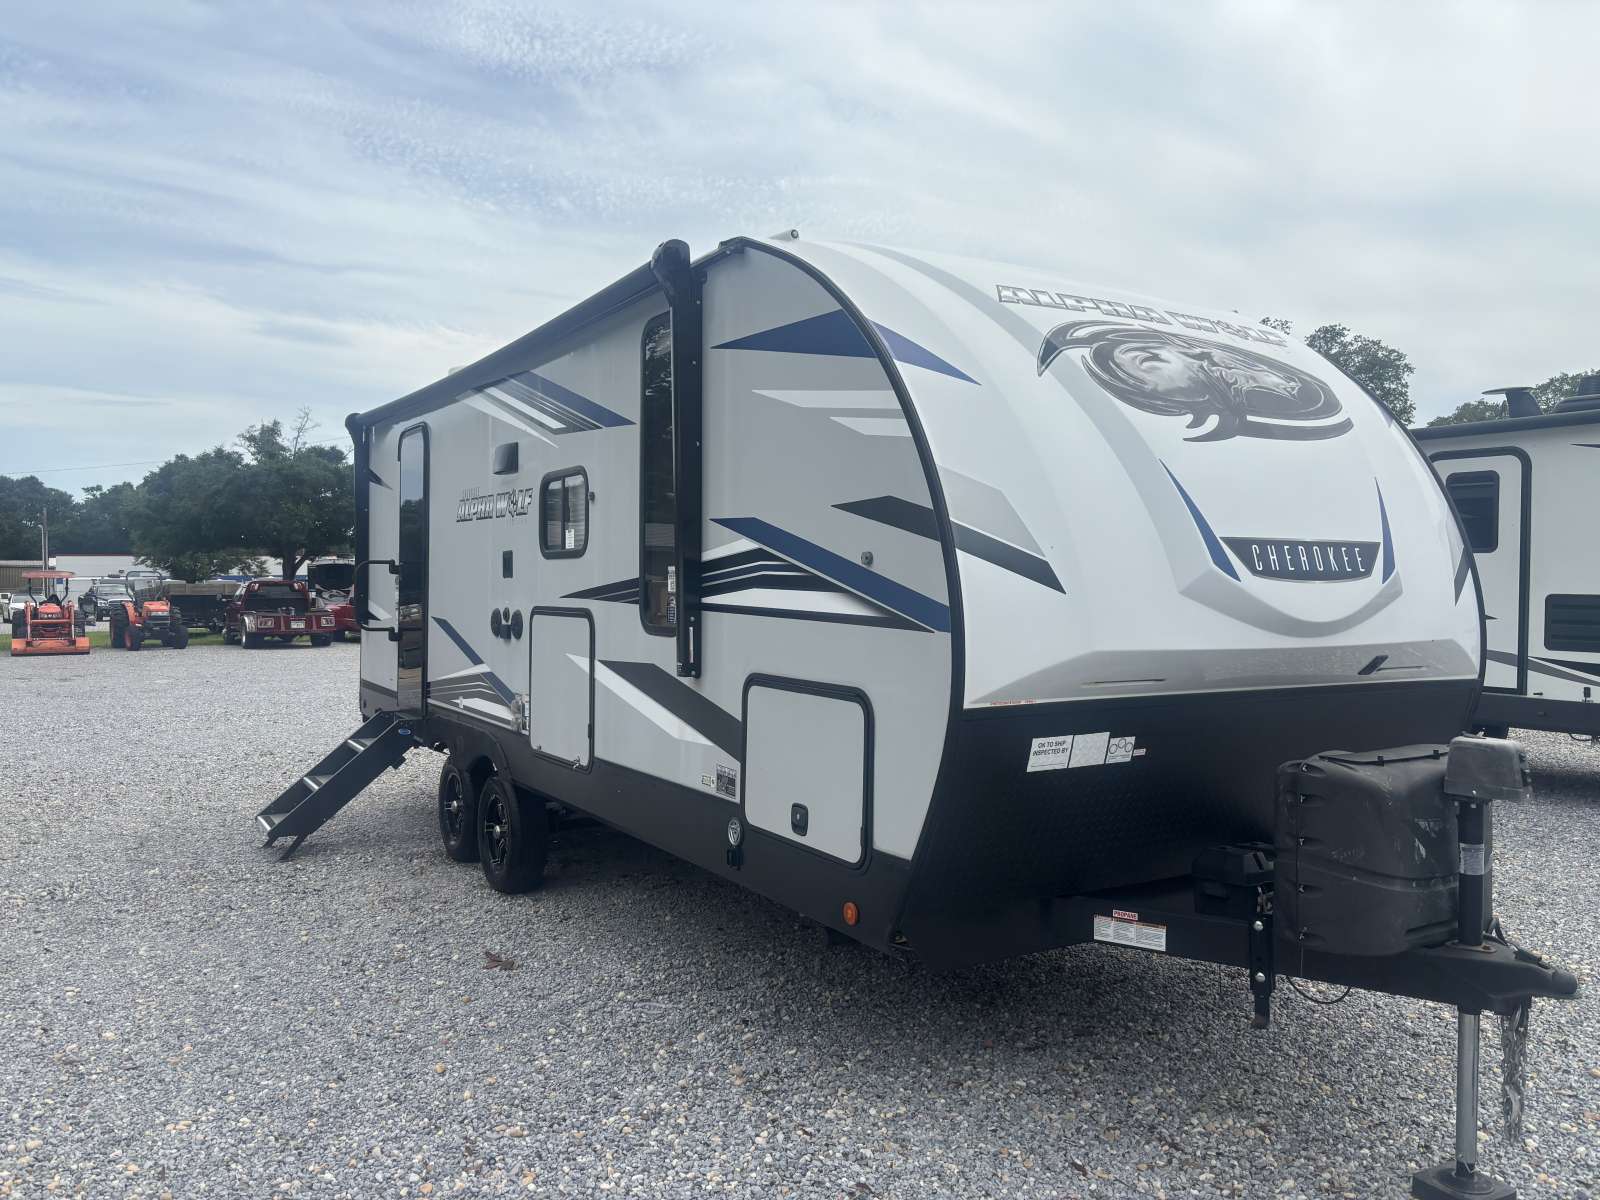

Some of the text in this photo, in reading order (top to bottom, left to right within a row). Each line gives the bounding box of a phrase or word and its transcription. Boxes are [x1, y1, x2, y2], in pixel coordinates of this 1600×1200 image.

[996, 285, 1171, 325] ALPHA
[456, 494, 494, 522] ALPHA
[1251, 544, 1366, 572] CHEROKEE
[1033, 748, 1061, 757] INSPECTED
[1114, 910, 1137, 920] PROPANE
